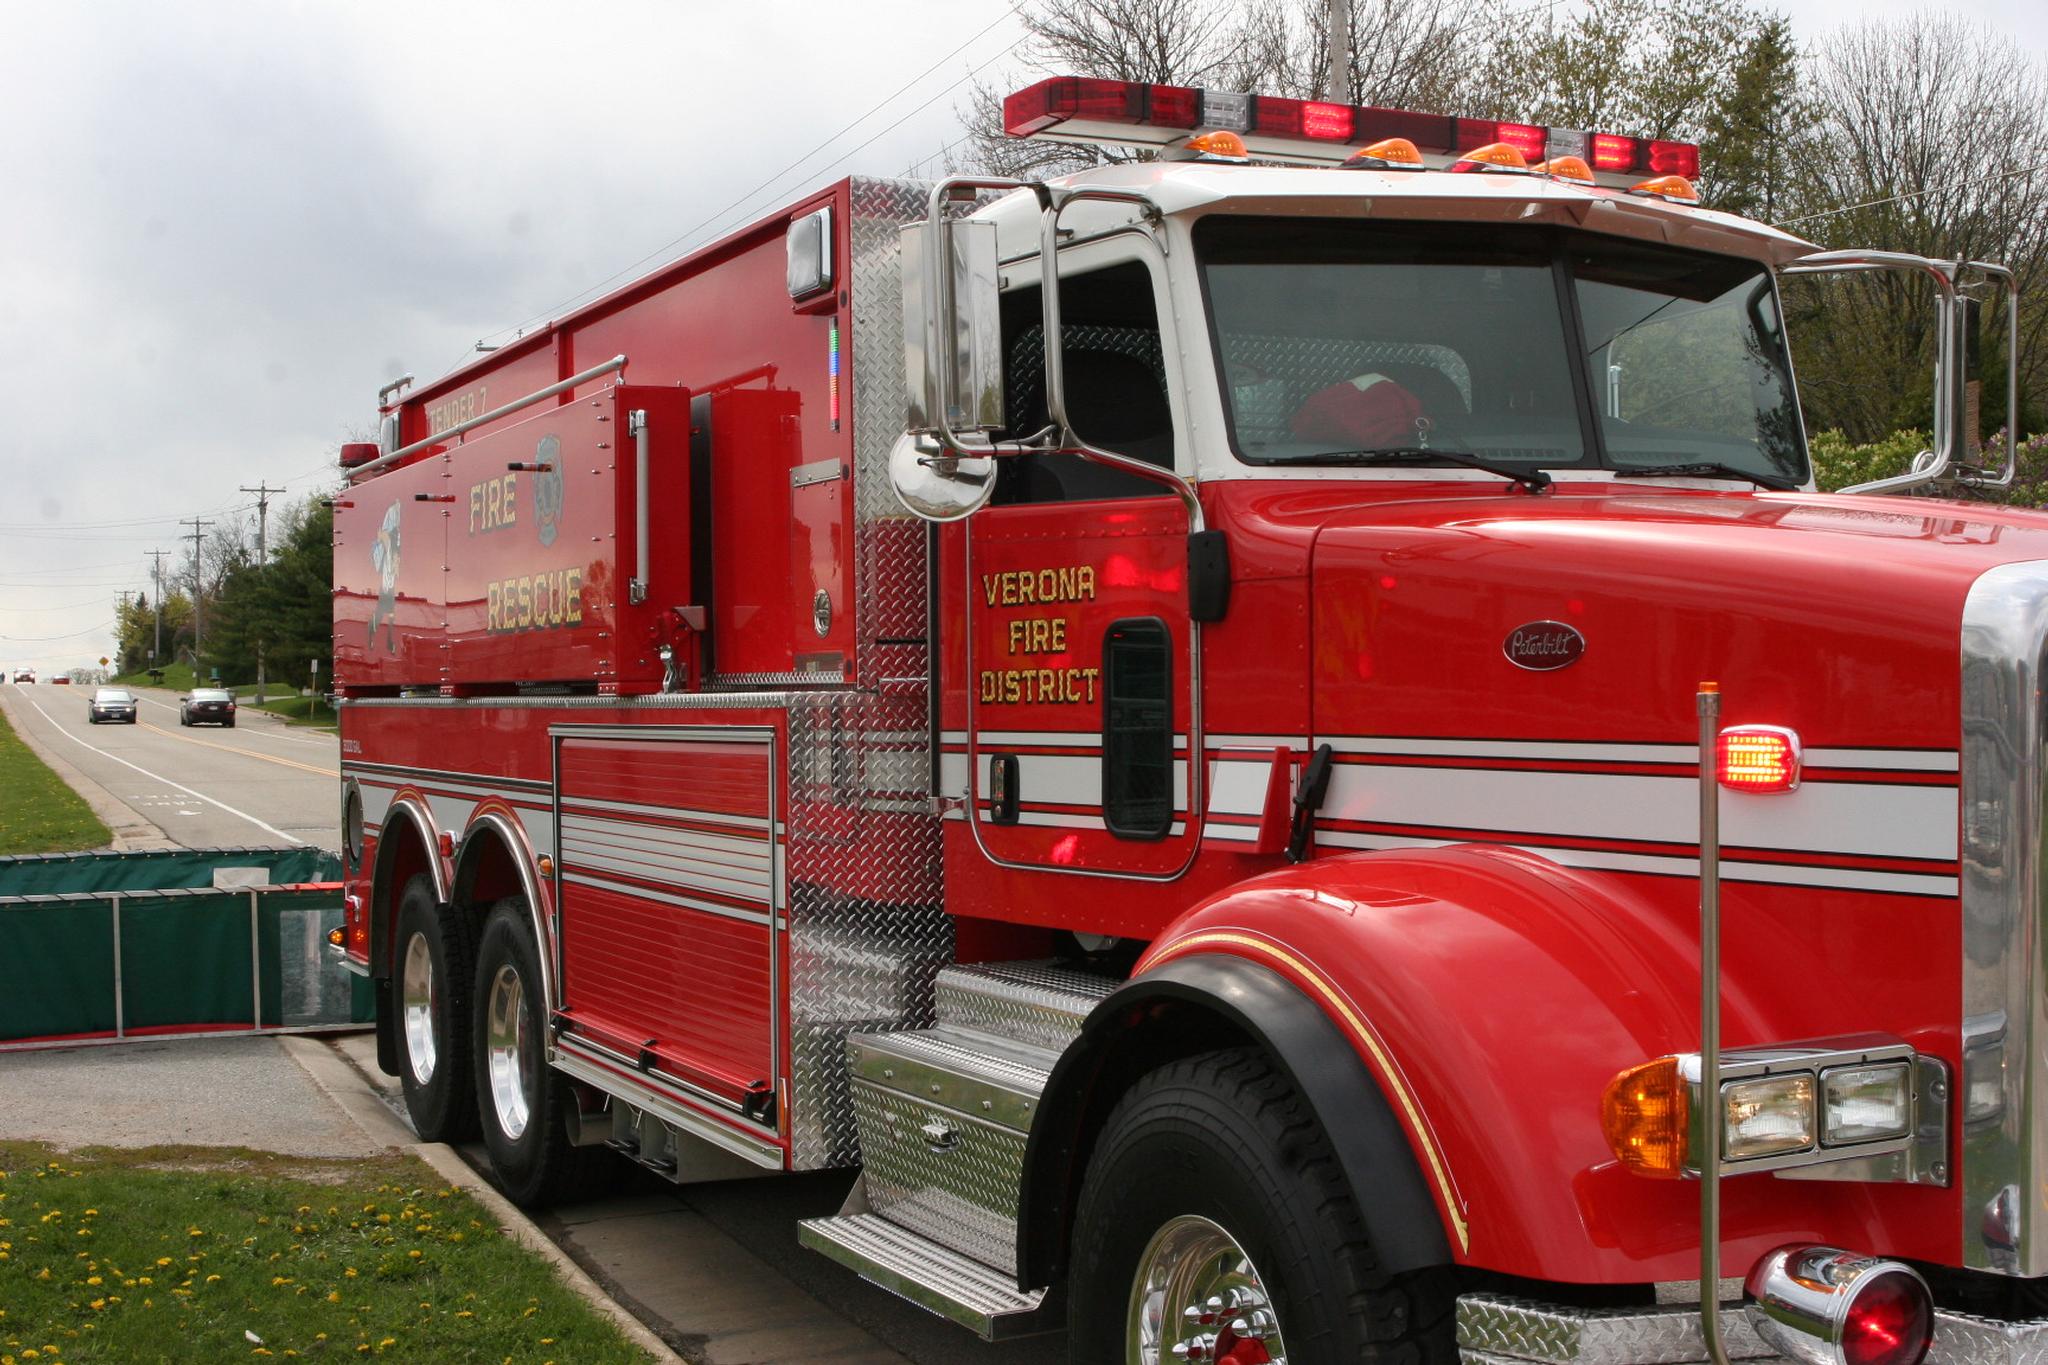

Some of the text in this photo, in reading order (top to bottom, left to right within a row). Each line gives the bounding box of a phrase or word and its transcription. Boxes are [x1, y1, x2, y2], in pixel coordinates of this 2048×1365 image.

[430, 387, 487, 434] TENDER 7
[469, 473, 517, 537] FIRE
[487, 567, 582, 634] RESCUE
[983, 565, 1096, 607] VERONA
[1009, 618, 1066, 654] FIRE
[1511, 630, 1576, 658] Peterbilt
[980, 668, 1098, 704] DISTRICT
